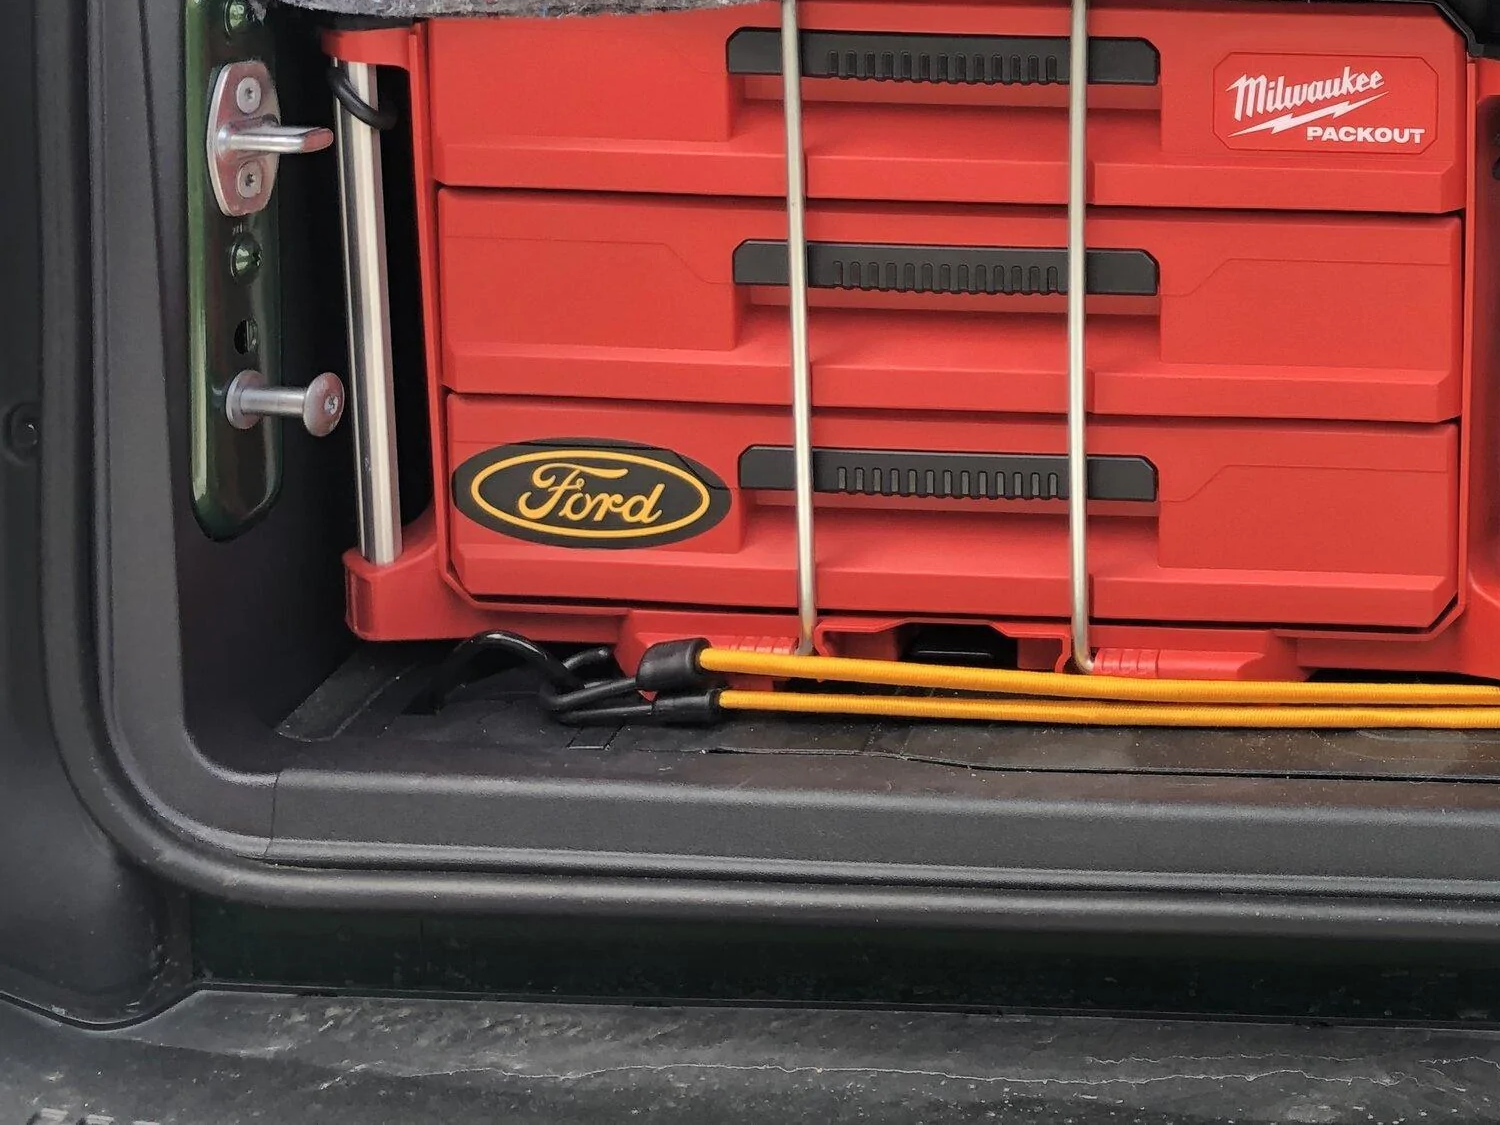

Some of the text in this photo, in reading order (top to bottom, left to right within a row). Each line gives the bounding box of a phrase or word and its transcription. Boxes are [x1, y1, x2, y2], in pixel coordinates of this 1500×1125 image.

[1225, 65, 1385, 122] Milwaukee
[1306, 125, 1425, 144] PACKOUT
[518, 462, 664, 524] Ford
